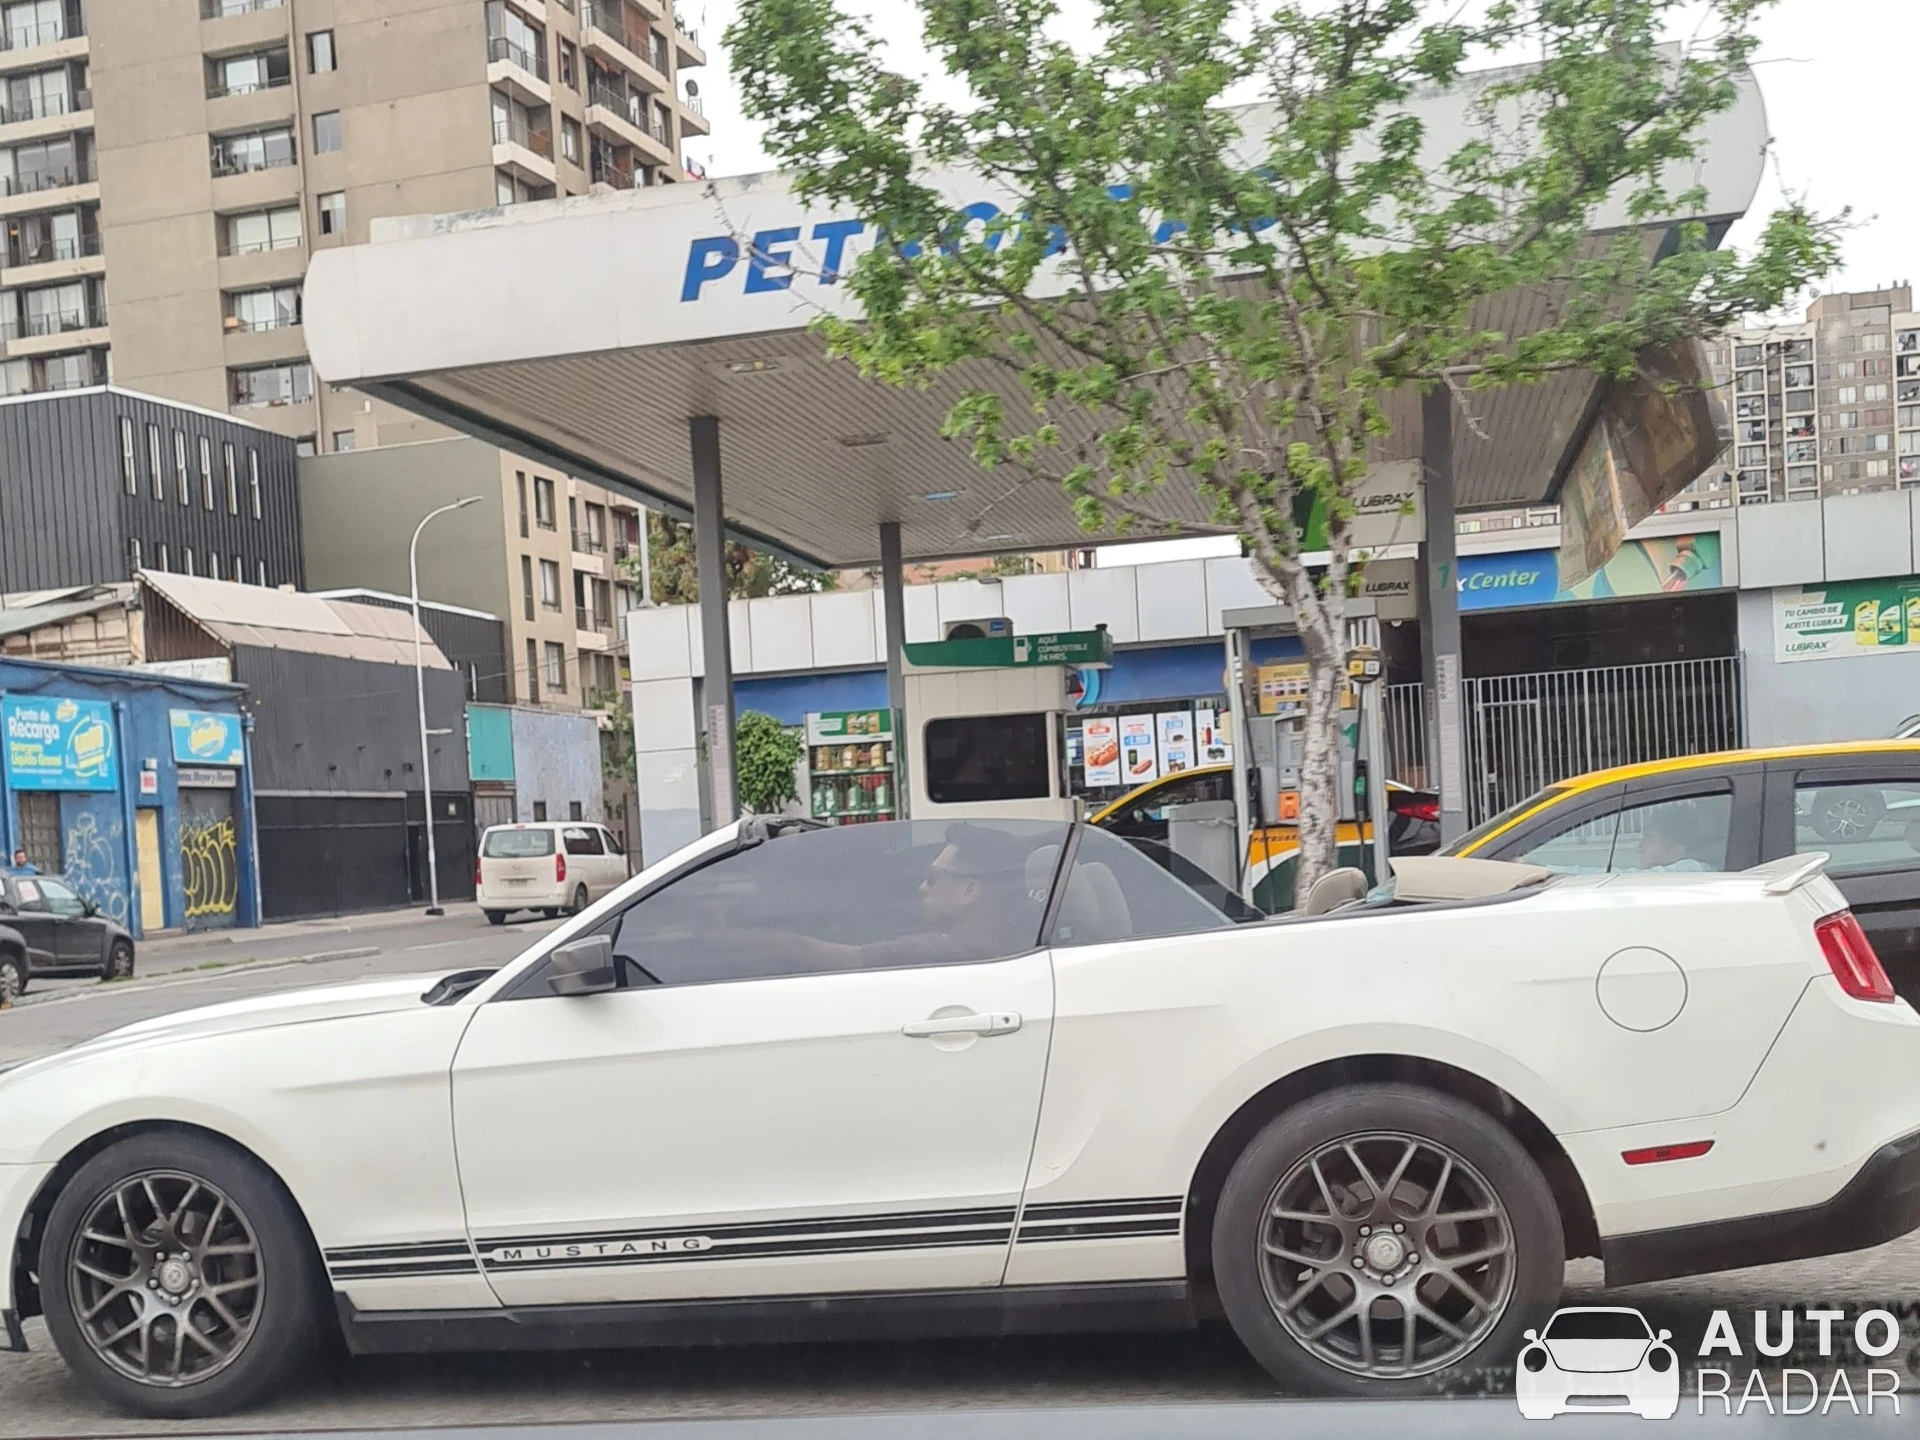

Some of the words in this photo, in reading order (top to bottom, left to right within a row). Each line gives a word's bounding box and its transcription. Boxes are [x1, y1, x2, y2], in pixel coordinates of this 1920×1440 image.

[1797, 607, 1826, 616] CAMBIO
[1828, 605, 1838, 613] DE
[1785, 621, 1811, 629] ACEITE
[1785, 642, 1828, 652] LUBRAX
[8, 716, 60, 745] Recarga
[504, 1239, 700, 1259] MUSTANG
